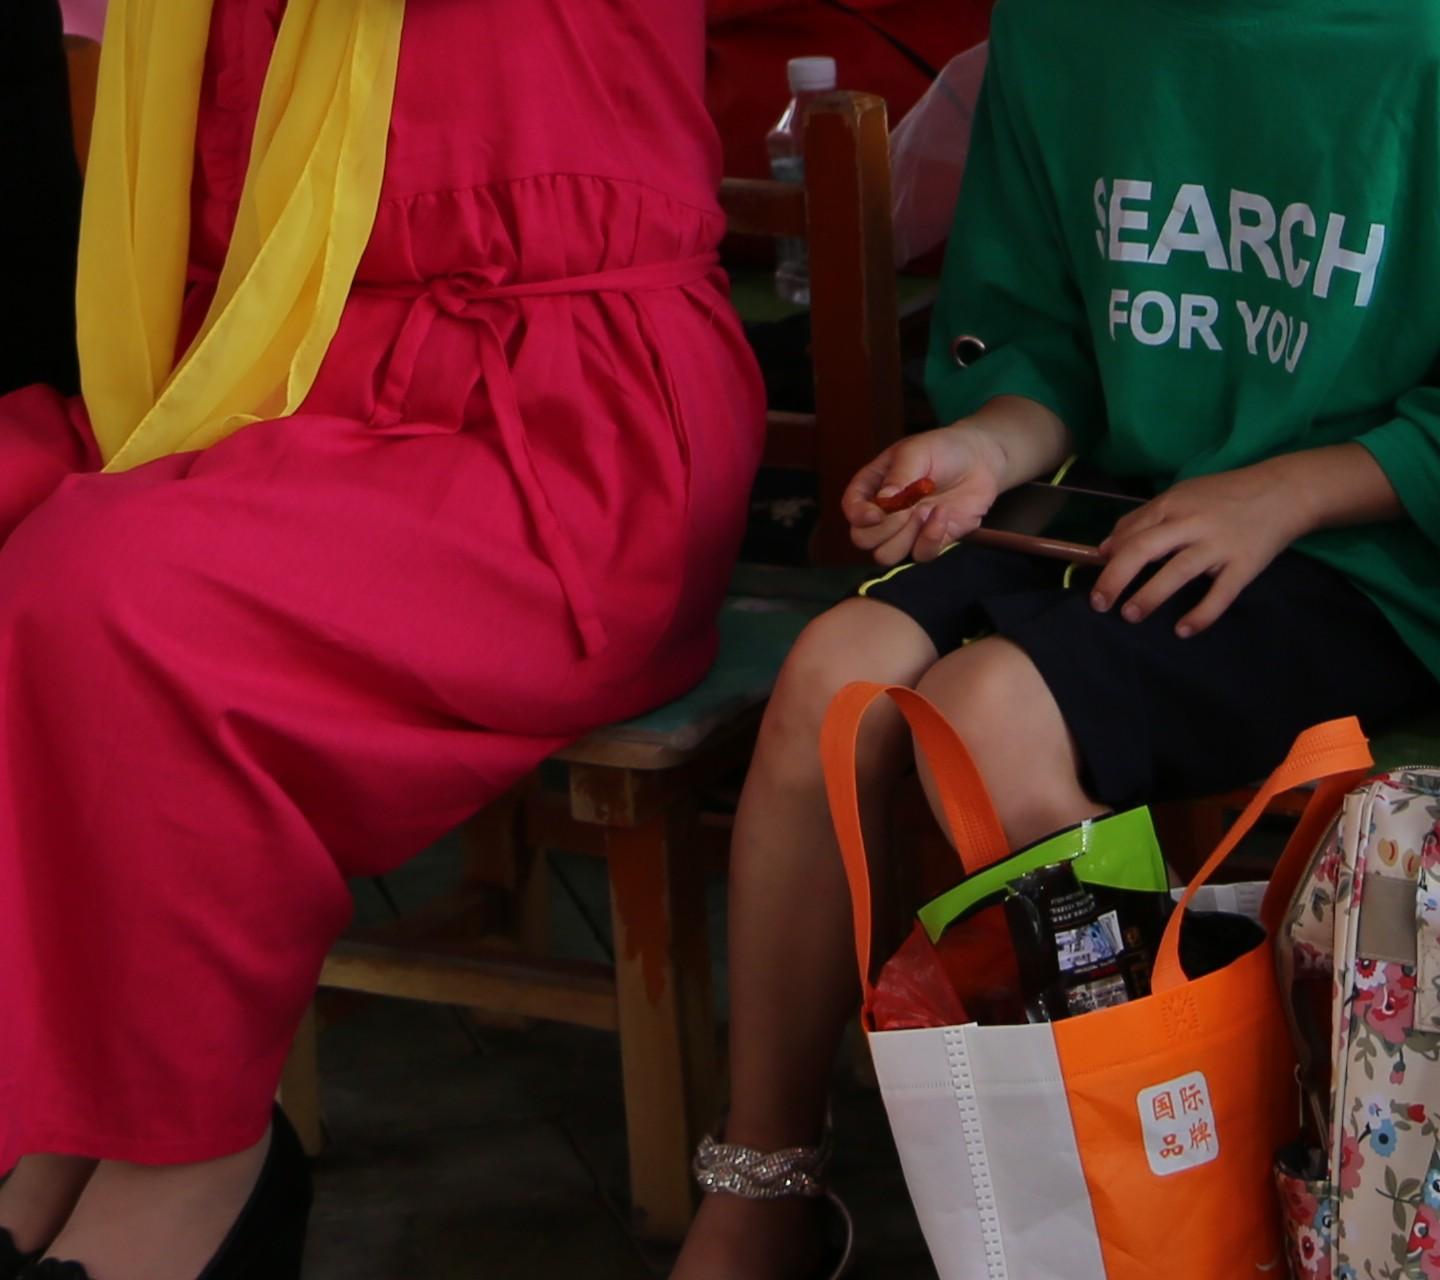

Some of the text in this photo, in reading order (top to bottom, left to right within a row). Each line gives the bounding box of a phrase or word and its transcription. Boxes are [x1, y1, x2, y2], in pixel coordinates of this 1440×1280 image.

[1093, 176, 1386, 308] SEARCH
[1108, 289, 1309, 374] FOR YOU
[1151, 1082, 1205, 1121] 国际
[1159, 1117, 1212, 1159] 品牌
